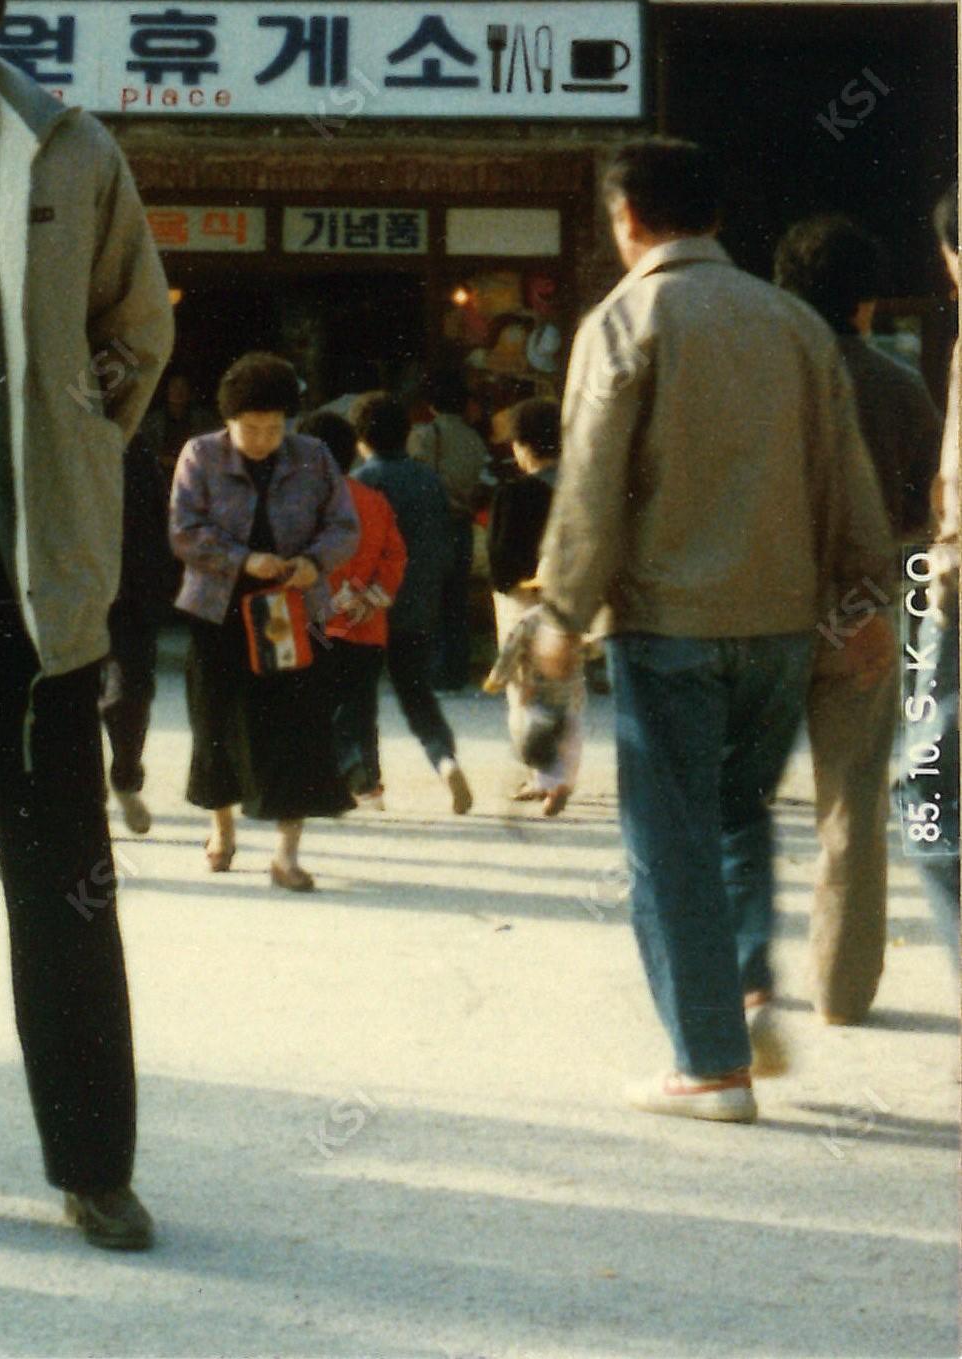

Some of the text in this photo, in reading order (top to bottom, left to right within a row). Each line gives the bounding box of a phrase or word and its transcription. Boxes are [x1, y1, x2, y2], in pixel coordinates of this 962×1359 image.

[125, 8, 481, 89] 휴게소
[119, 85, 233, 112] place
[300, 210, 419, 249] 기념품
